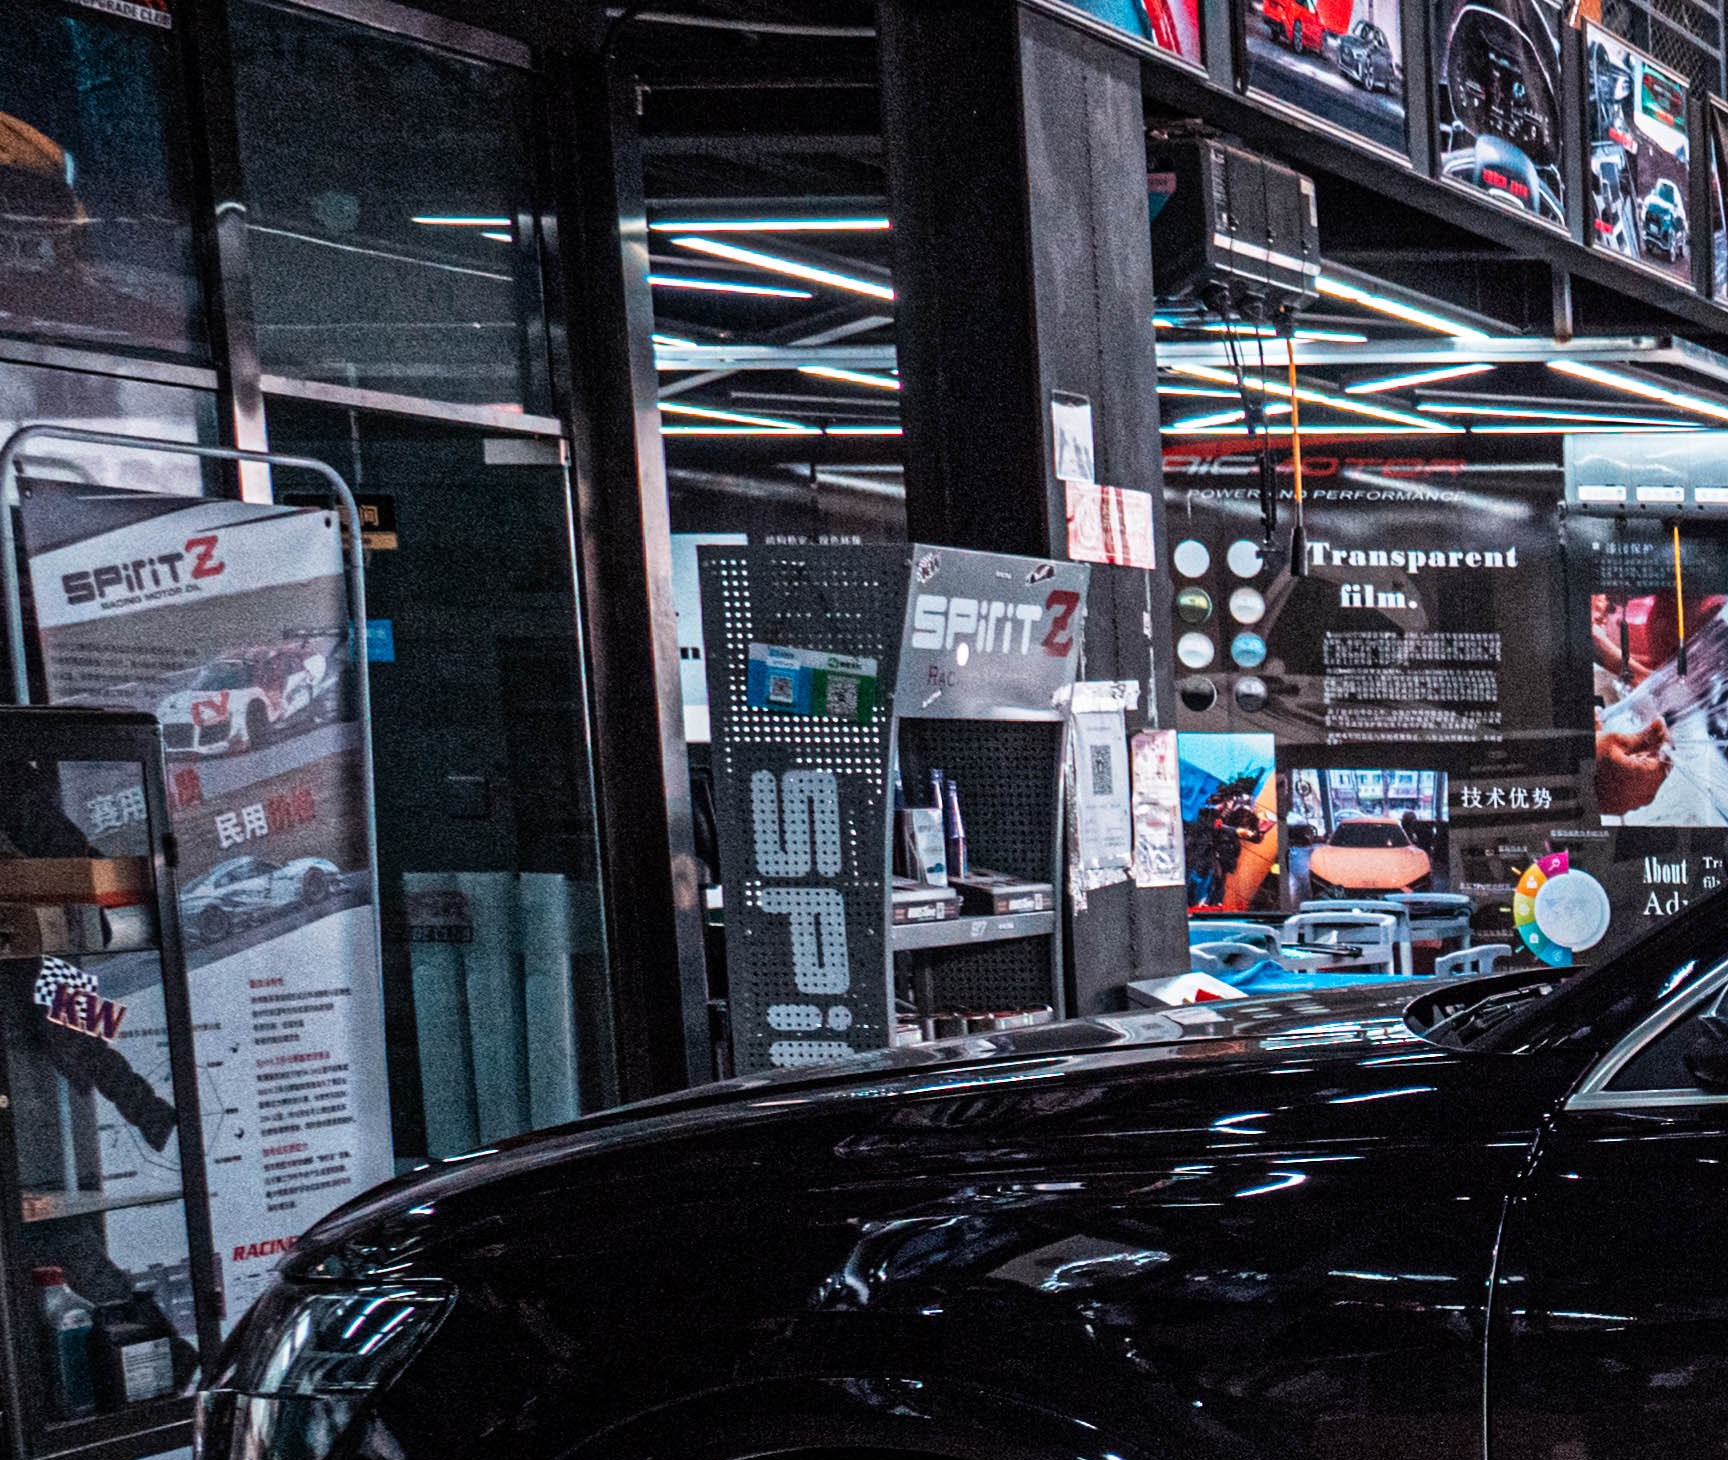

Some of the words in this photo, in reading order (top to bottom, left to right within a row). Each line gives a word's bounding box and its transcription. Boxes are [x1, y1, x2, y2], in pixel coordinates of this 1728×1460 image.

[1187, 487, 1262, 501] POWER
[1313, 489, 1467, 502] PERFORMANCE
[1306, 541, 1519, 574] Transparent
[1339, 583, 1418, 609] film.
[1460, 786, 1553, 810] 技术优势
[1643, 856, 1688, 884] About
